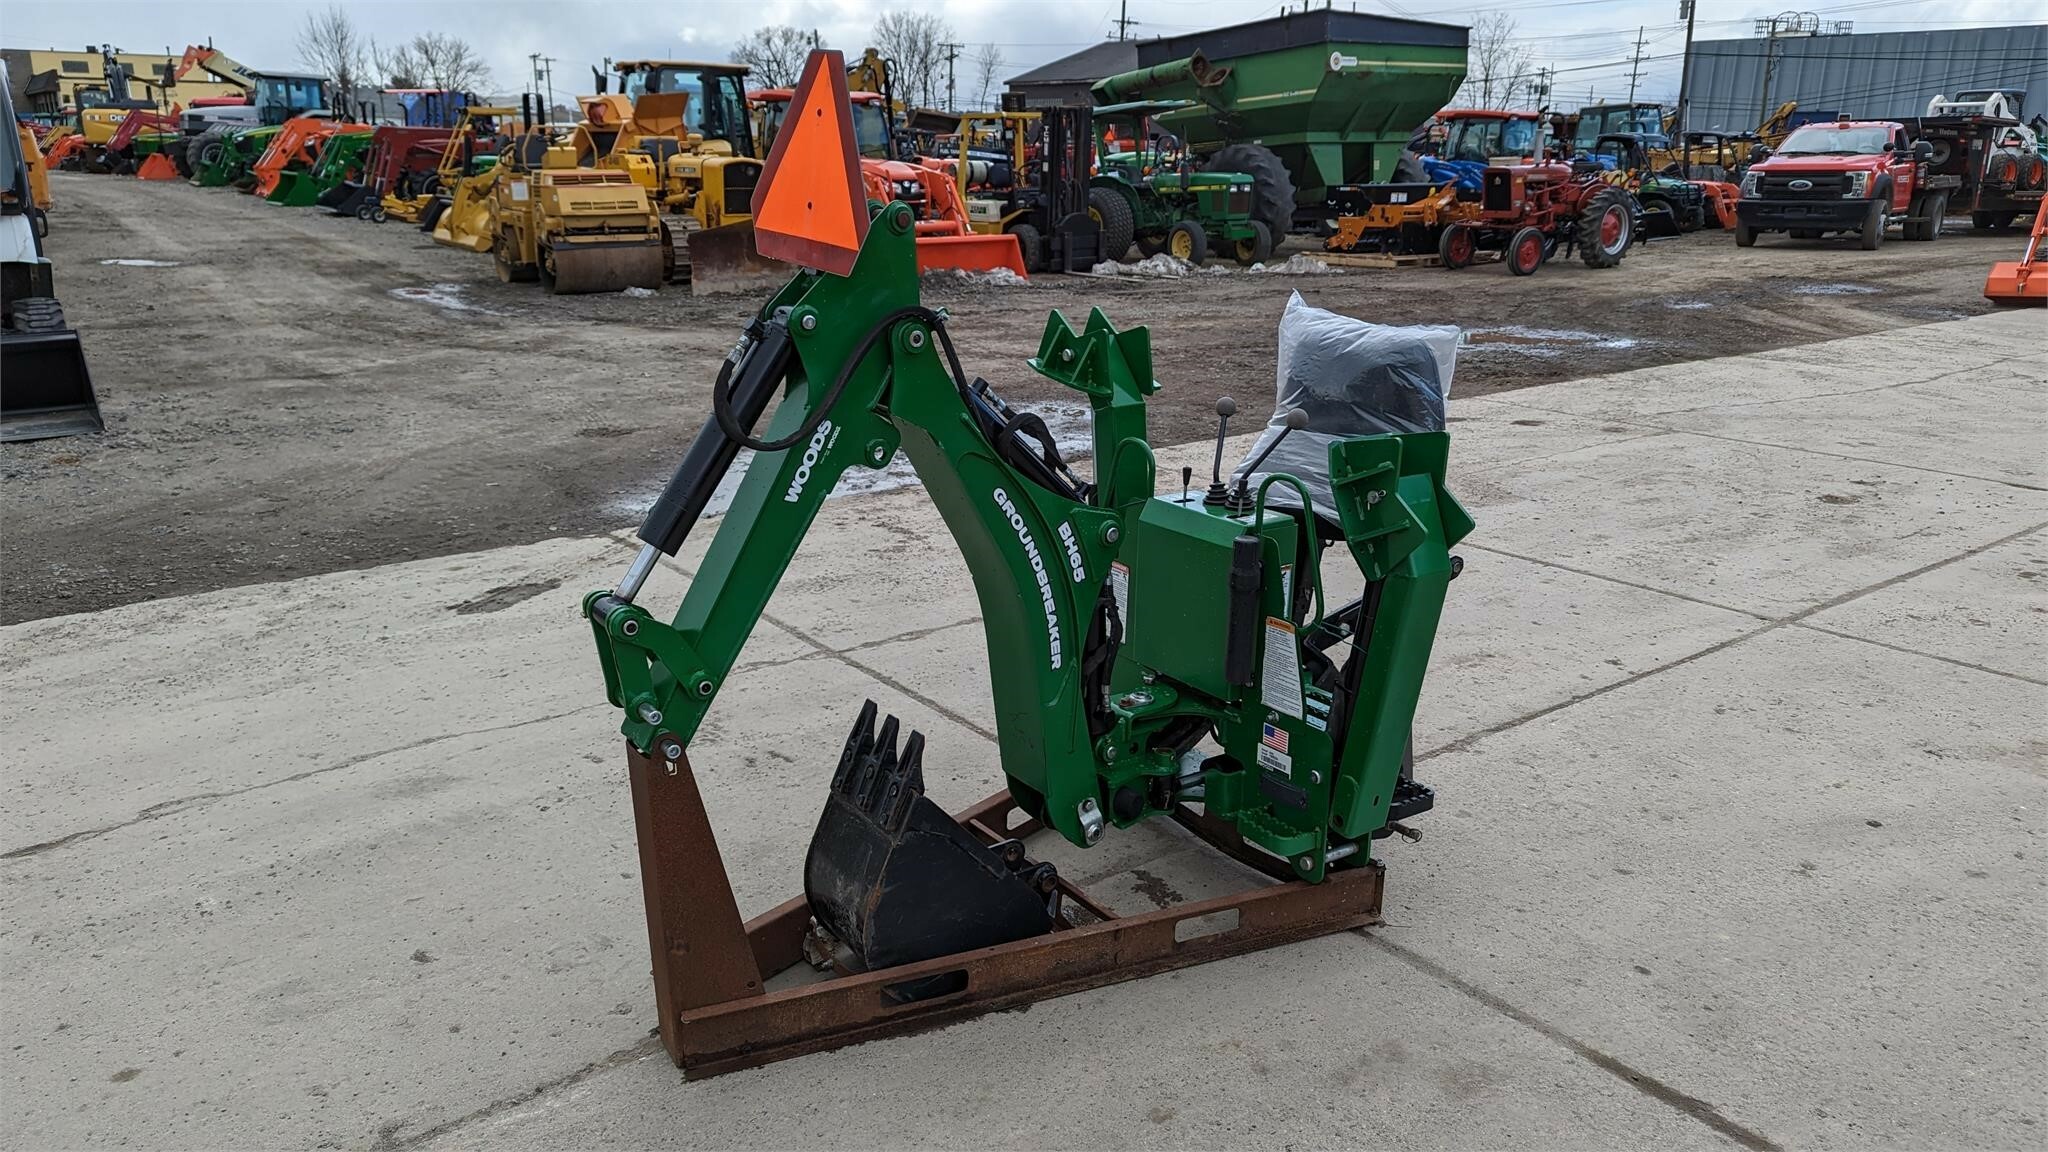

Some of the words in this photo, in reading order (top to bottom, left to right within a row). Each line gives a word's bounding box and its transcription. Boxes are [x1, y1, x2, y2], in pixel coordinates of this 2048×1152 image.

[784, 420, 832, 502] WOODS
[993, 487, 1062, 671] GROUNDBREAKER
[1057, 521, 1086, 583] BH65
